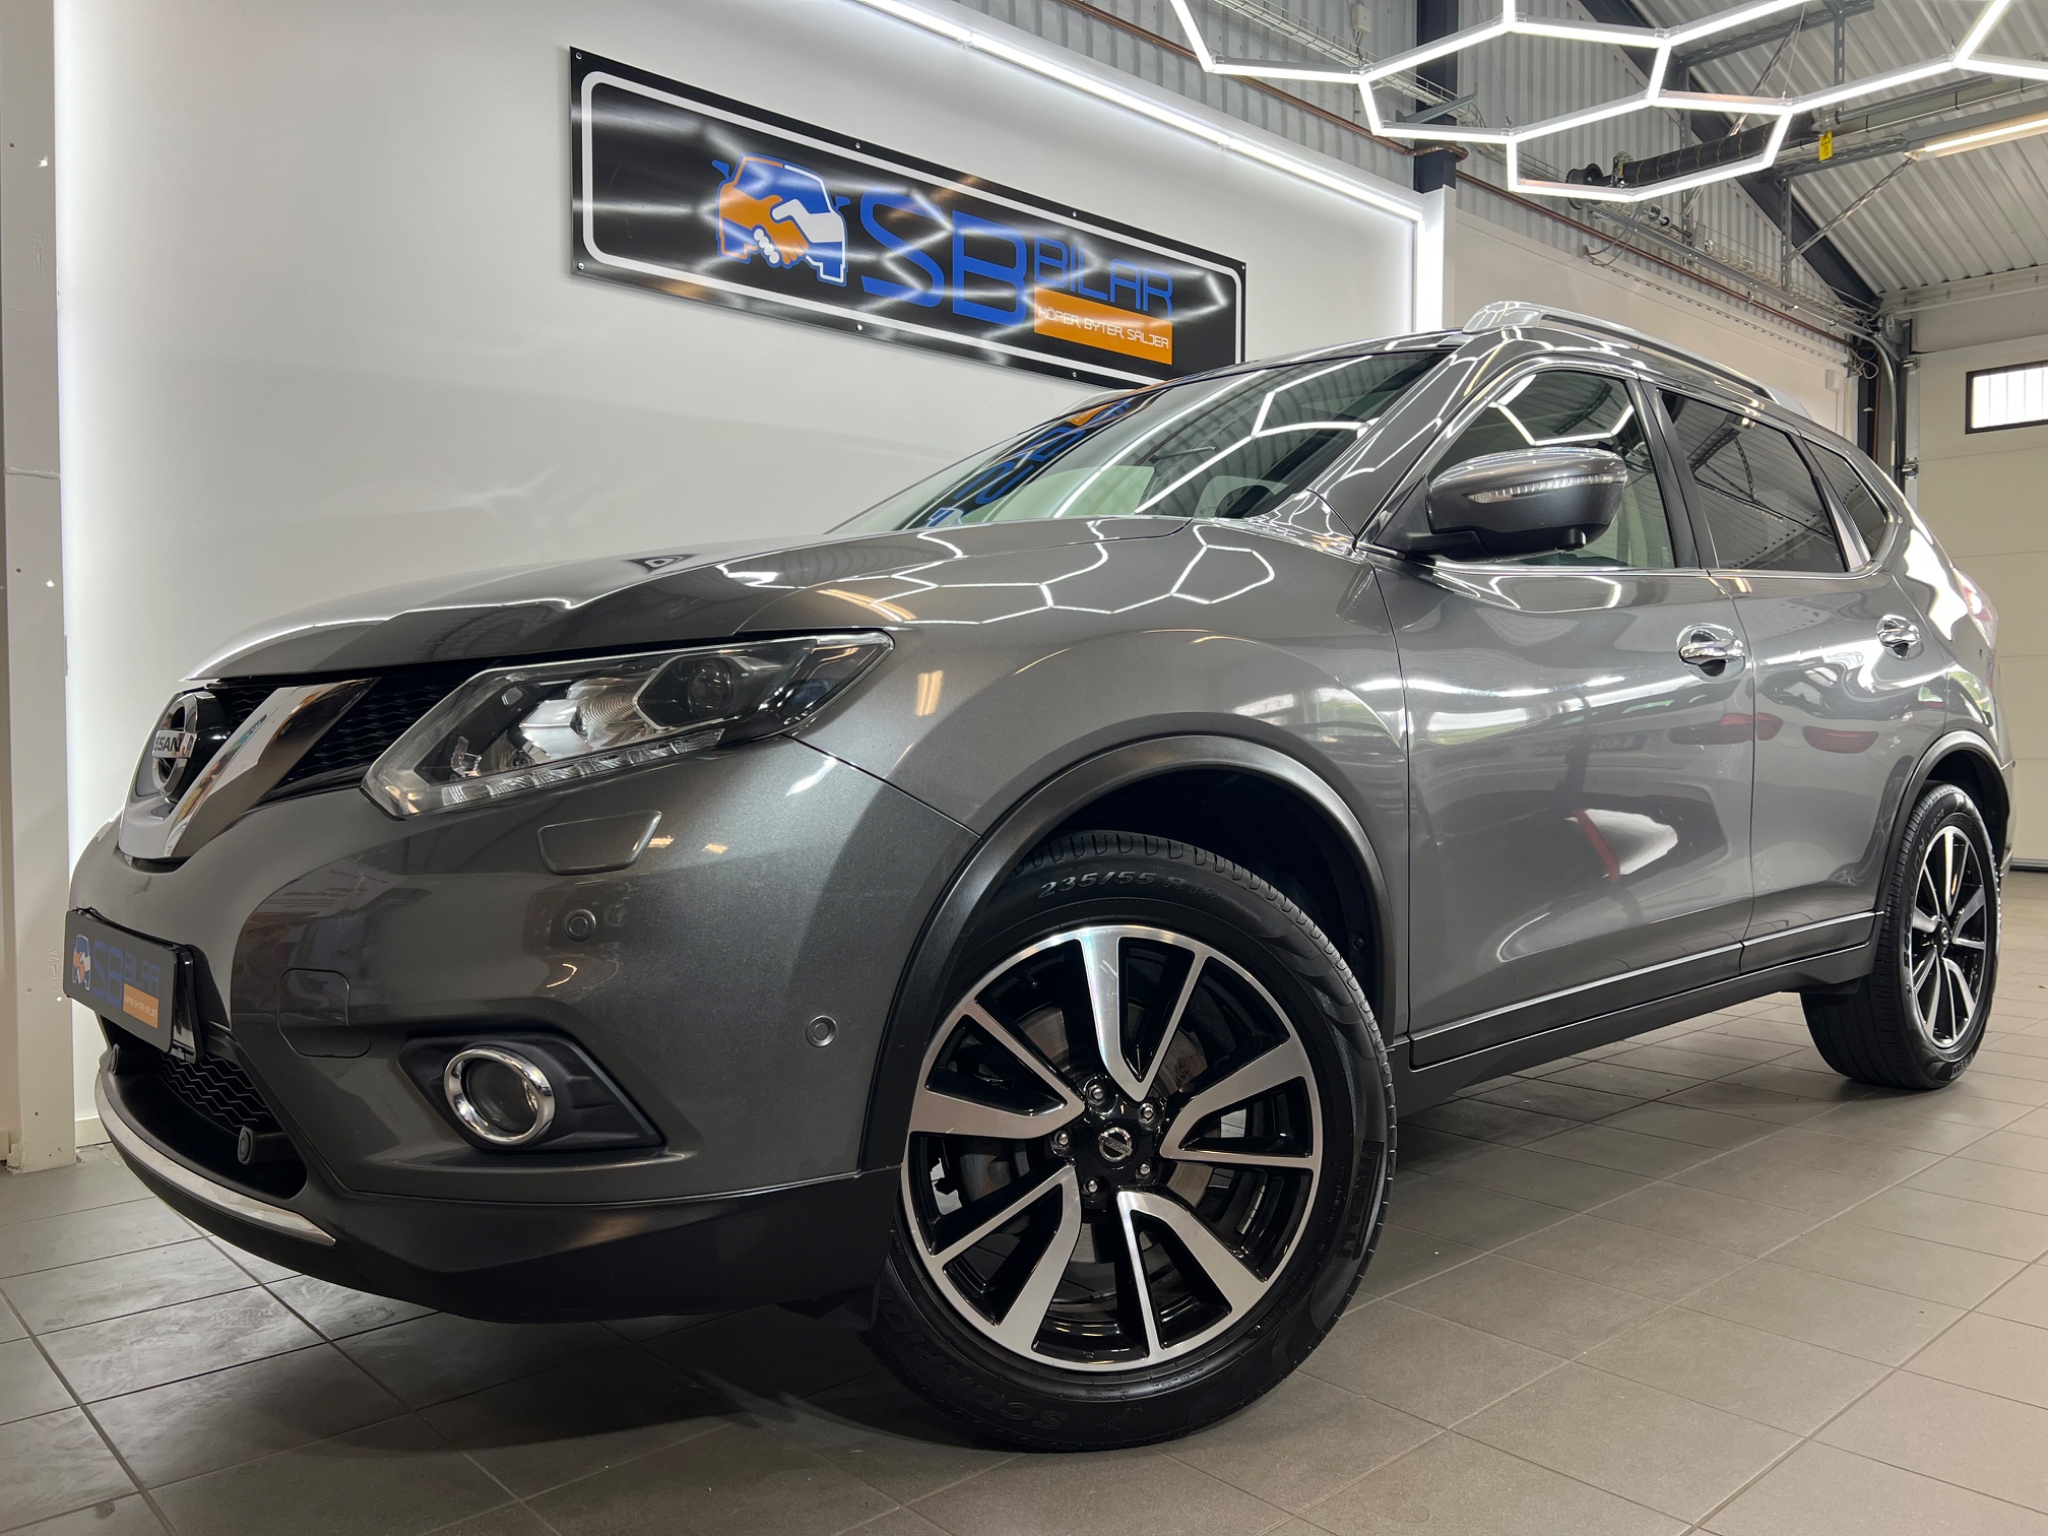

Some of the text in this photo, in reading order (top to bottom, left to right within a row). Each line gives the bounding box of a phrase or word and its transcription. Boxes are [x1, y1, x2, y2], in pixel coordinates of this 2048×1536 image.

[859, 187, 1174, 327] SB BILAR
[1127, 327, 1170, 350] SÄLJER
[1037, 869, 1158, 900] 235/55
